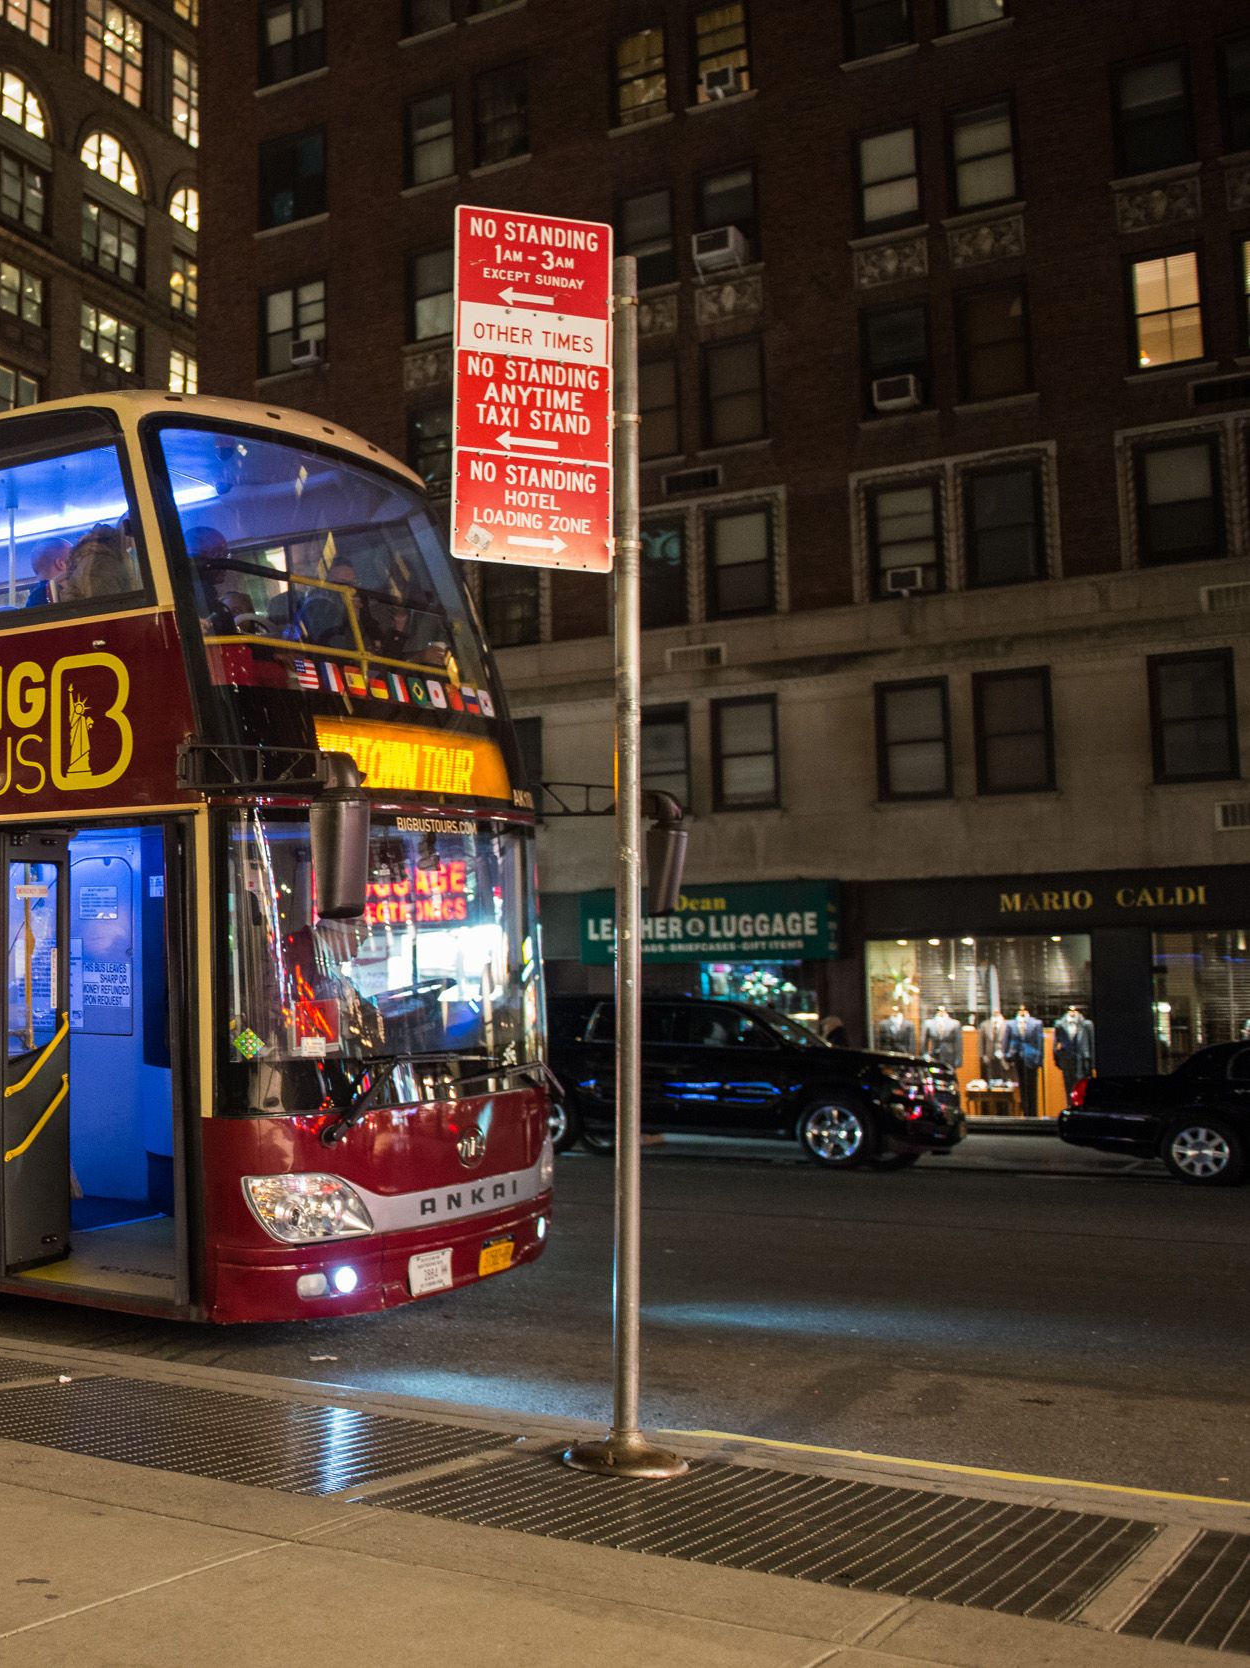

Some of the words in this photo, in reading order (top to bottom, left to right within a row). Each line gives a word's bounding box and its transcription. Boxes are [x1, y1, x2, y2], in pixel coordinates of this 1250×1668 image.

[470, 217, 497, 239] NO
[505, 222, 599, 252] STANDING
[494, 245, 523, 263] 1AM
[540, 251, 575, 270] 3AM
[483, 268, 531, 283] EXCEPT
[535, 274, 585, 290] SUNDAY
[474, 322, 533, 345] OTHER
[541, 331, 593, 353] TIMES
[467, 356, 494, 378] NO
[505, 359, 600, 390] STANDING
[483, 382, 584, 413] ANYTIME
[476, 403, 519, 428] TAXI
[529, 410, 591, 436] STAND
[470, 460, 497, 483] NO
[505, 464, 597, 494] STANDING
[504, 489, 561, 511] HOTEL
[473, 507, 543, 530] LOADING
[548, 515, 592, 535] ZONE
[421, 745, 475, 794] TOUR
[396, 816, 478, 836] BIGBUSTOURS.COM
[673, 894, 727, 912] Dean
[1000, 889, 1094, 913] MARIO
[1116, 885, 1207, 908] CALDI
[587, 915, 684, 941] LEHER
[708, 912, 818, 938] LUGGAGE
[100, 974, 119, 984] SHARP
[106, 963, 127, 974] LEAVES
[100, 985, 130, 996] REFUNDED
[420, 1179, 518, 1216] ANKAI
